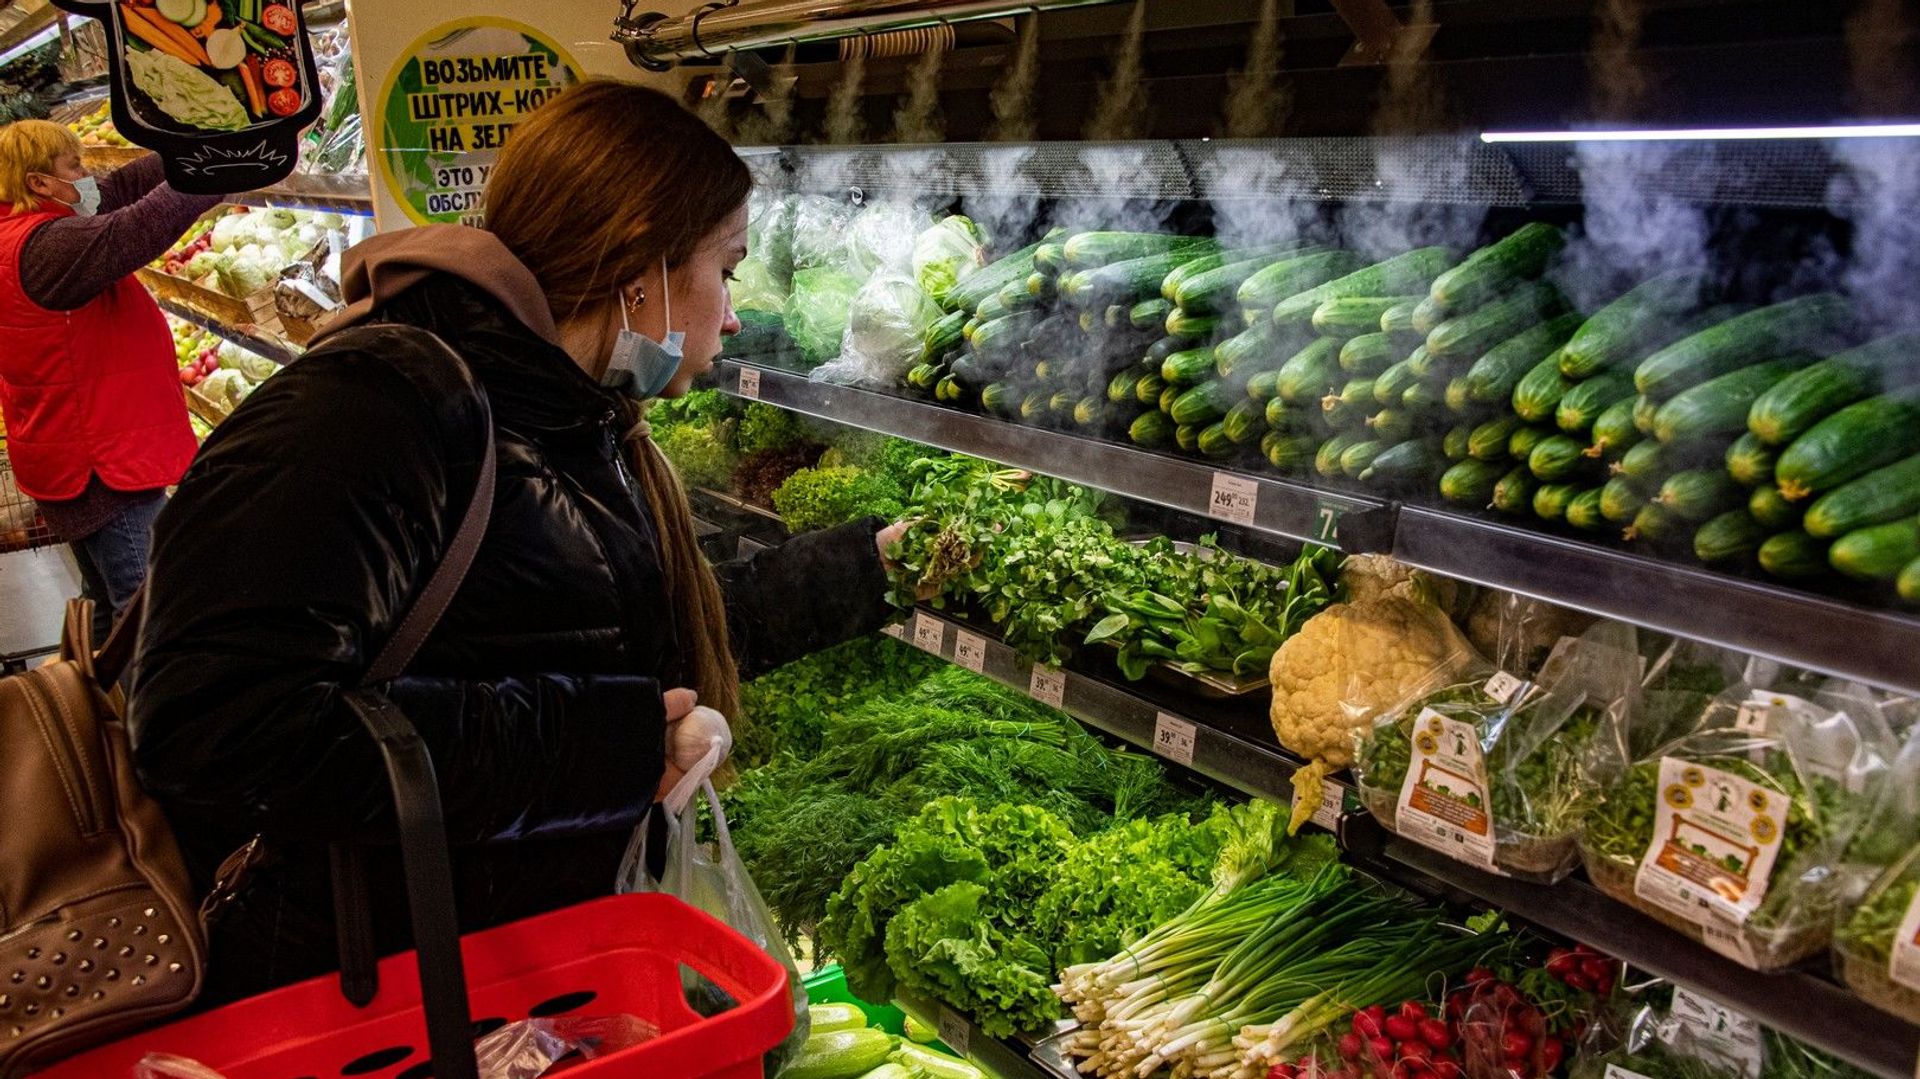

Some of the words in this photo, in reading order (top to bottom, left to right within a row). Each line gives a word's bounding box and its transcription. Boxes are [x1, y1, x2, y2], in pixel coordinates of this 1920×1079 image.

[424, 55, 547, 85] ВОЗЬМИТЕ
[430, 127, 464, 152] НА
[438, 167, 473, 187] ЭТО
